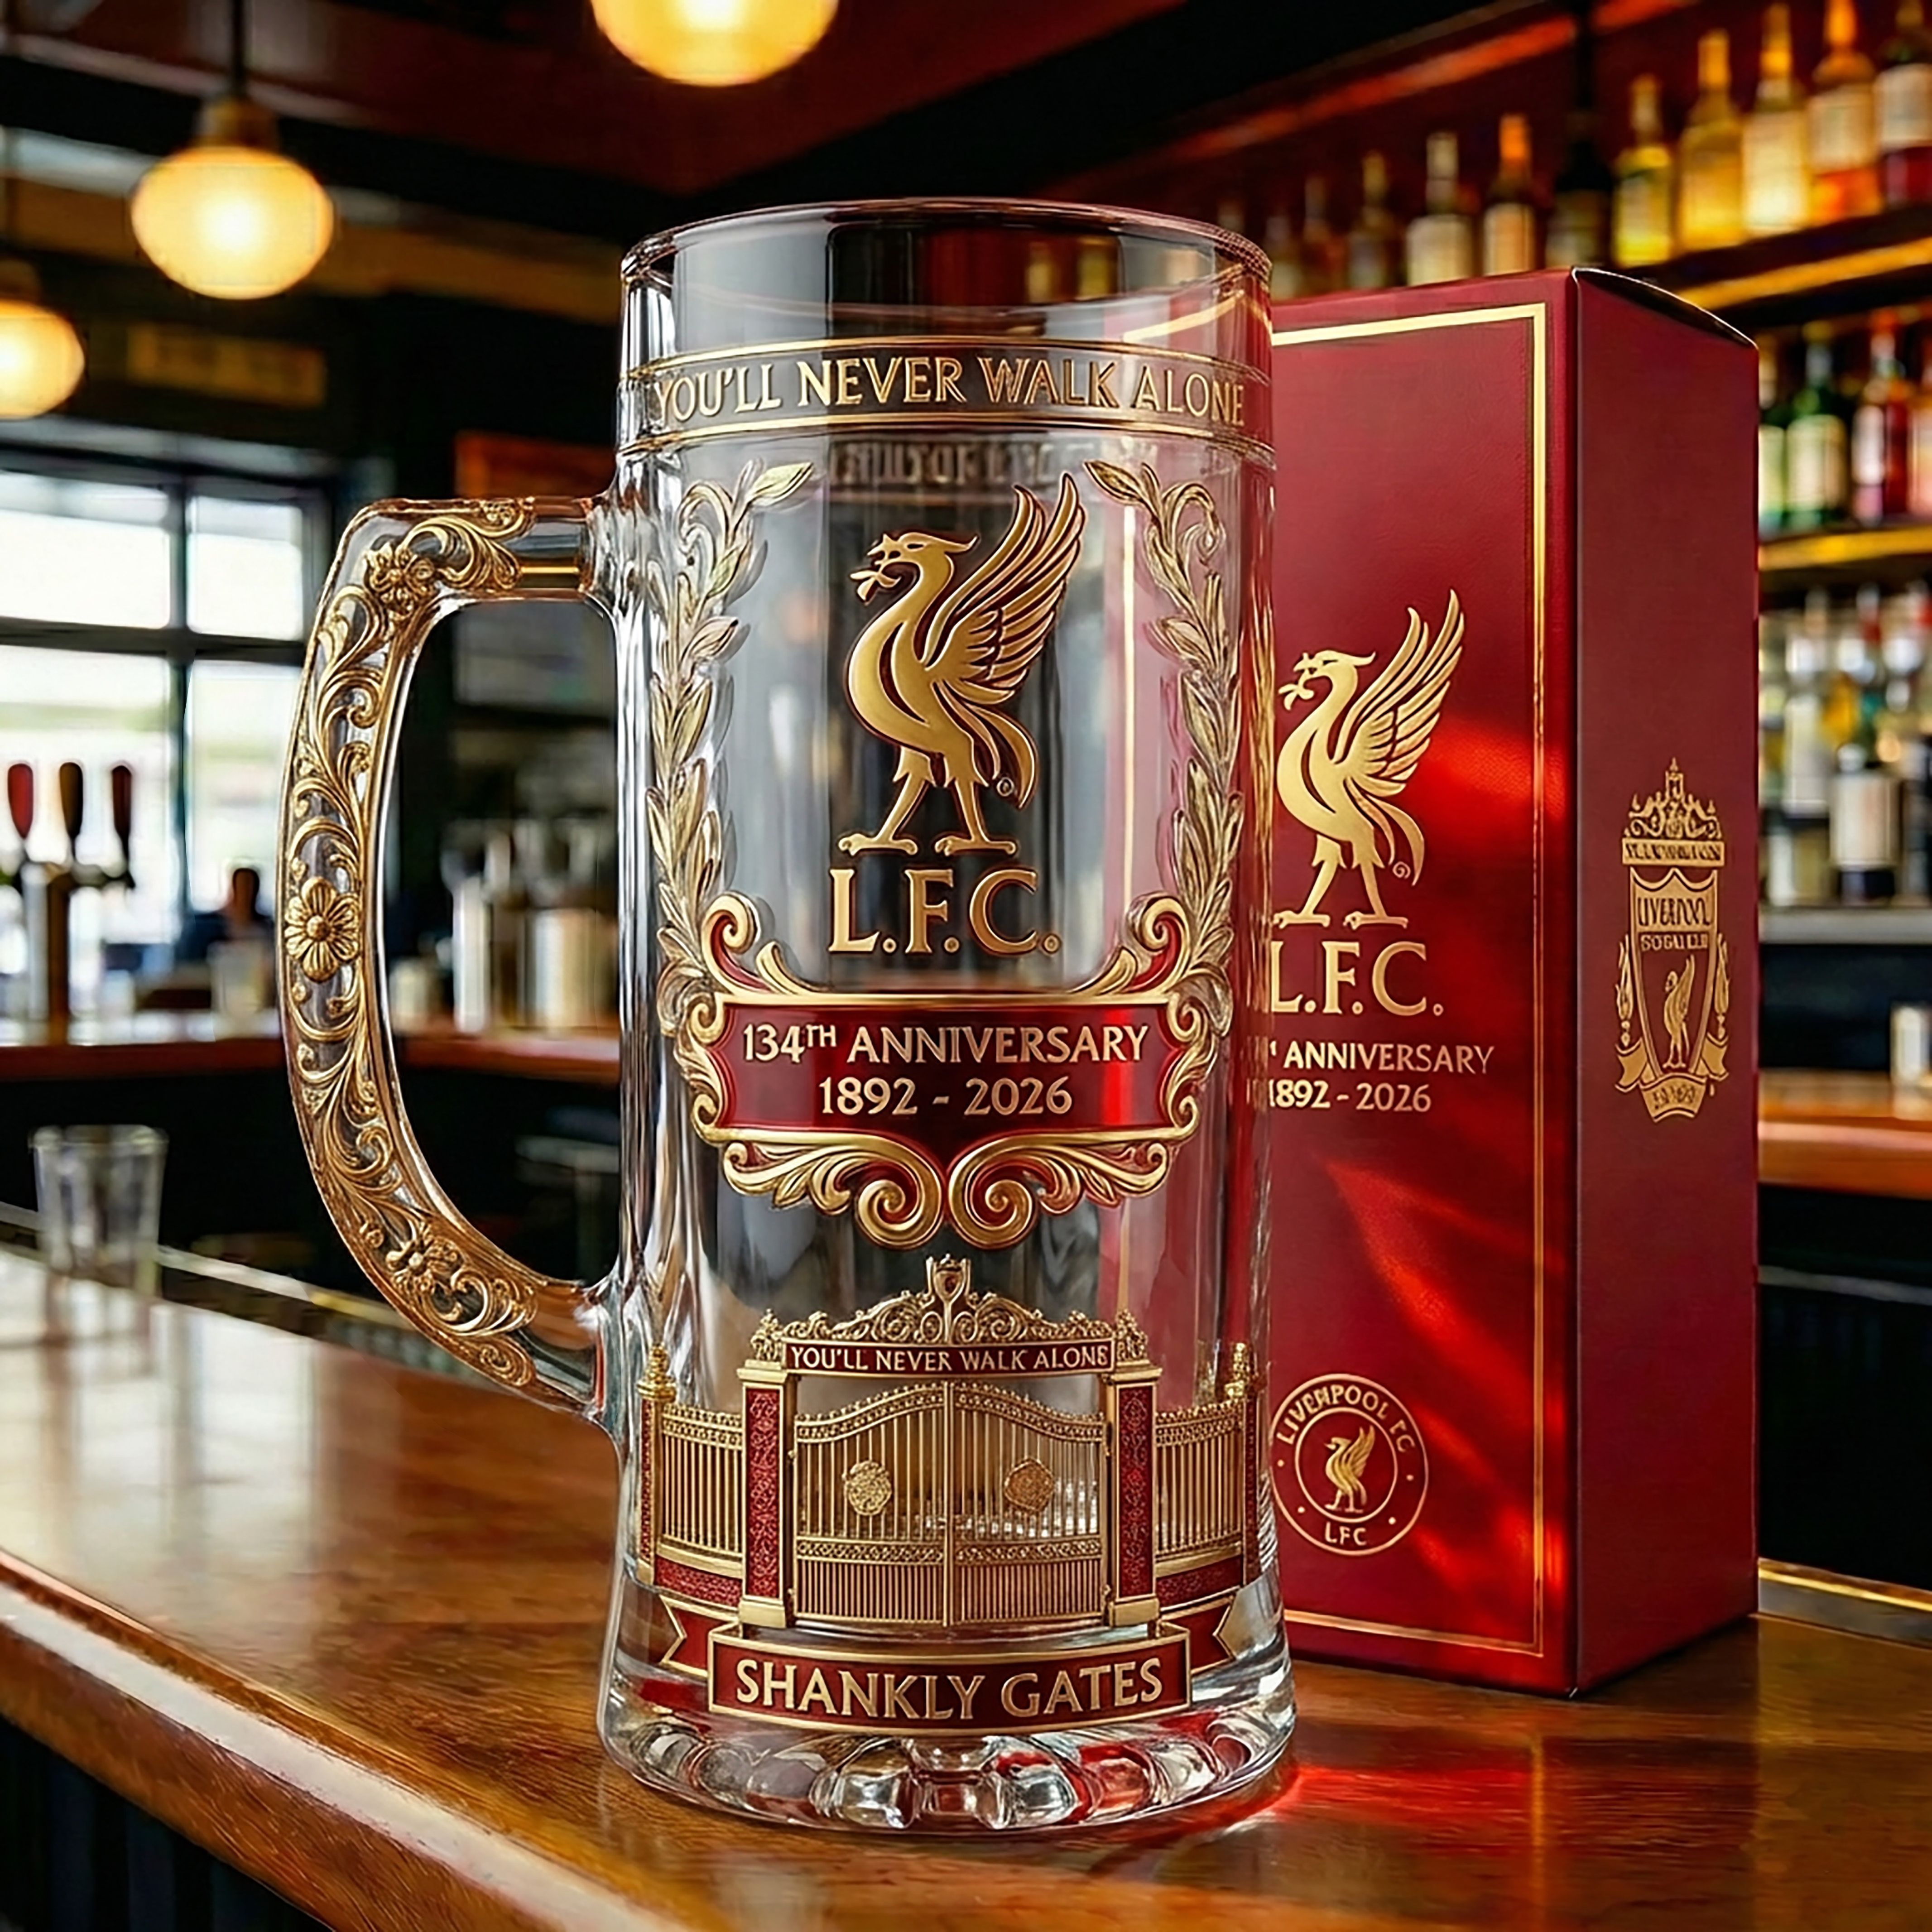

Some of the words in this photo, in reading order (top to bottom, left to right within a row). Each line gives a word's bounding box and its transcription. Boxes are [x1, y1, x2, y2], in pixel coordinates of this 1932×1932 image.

[654, 364, 782, 423] YOU'LL
[797, 357, 967, 408] NEVER
[977, 357, 1120, 409] WALK
[1130, 365, 1245, 428] ALONE
[828, 869, 1062, 954] L.F.C.
[846, 1026, 1148, 1063] ANNIVERSARY
[1283, 1041, 1495, 1074] ANNIVERSARY
[819, 1077, 918, 1116] 1892
[964, 1075, 1073, 1116] 2026
[1269, 1079, 1331, 1109] 1892
[1355, 1082, 1432, 1113] 2026
[791, 1346, 868, 1370] YOU'LL
[875, 1350, 952, 1372] NEVER
[959, 1349, 1028, 1370] WALK
[1390, 1420, 1416, 1452] FC
[1325, 1522, 1367, 1546] LFC
[736, 1659, 985, 1719] SHANKLY
[1001, 1658, 1163, 1717] GATES
